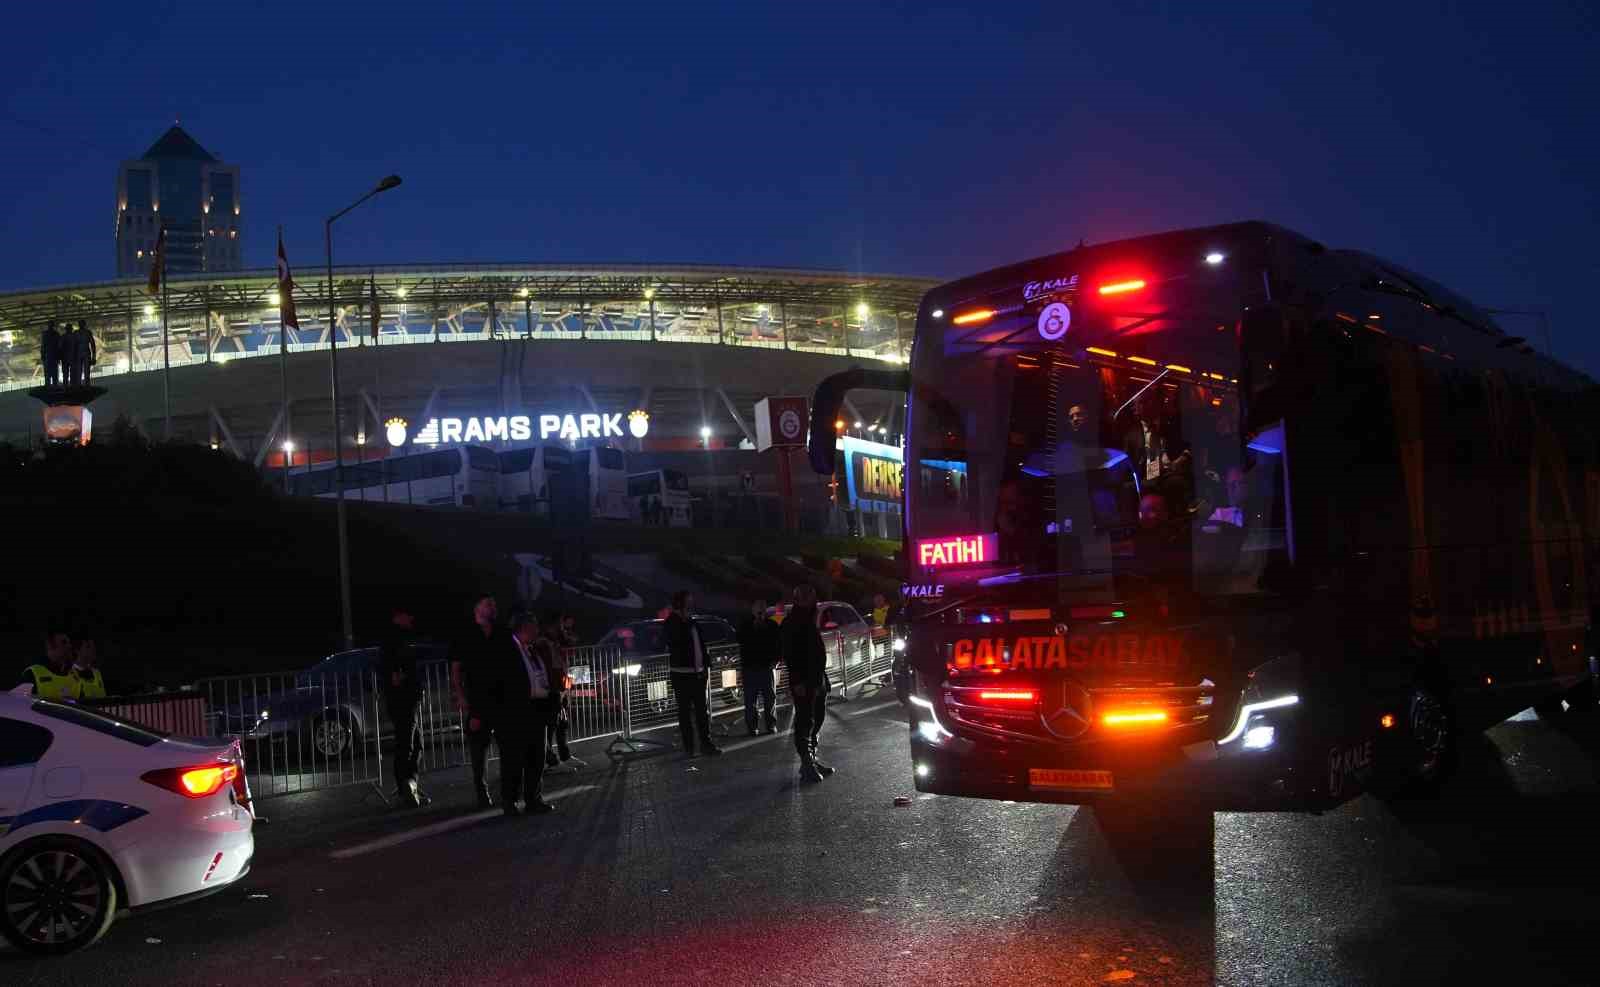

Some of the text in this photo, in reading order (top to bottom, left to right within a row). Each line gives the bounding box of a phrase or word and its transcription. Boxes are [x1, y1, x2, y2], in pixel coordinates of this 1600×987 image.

[1043, 274, 1079, 290] KALE
[442, 413, 623, 442] RAMS PARK
[920, 536, 984, 565] FATİHİ
[911, 584, 944, 598] KALE
